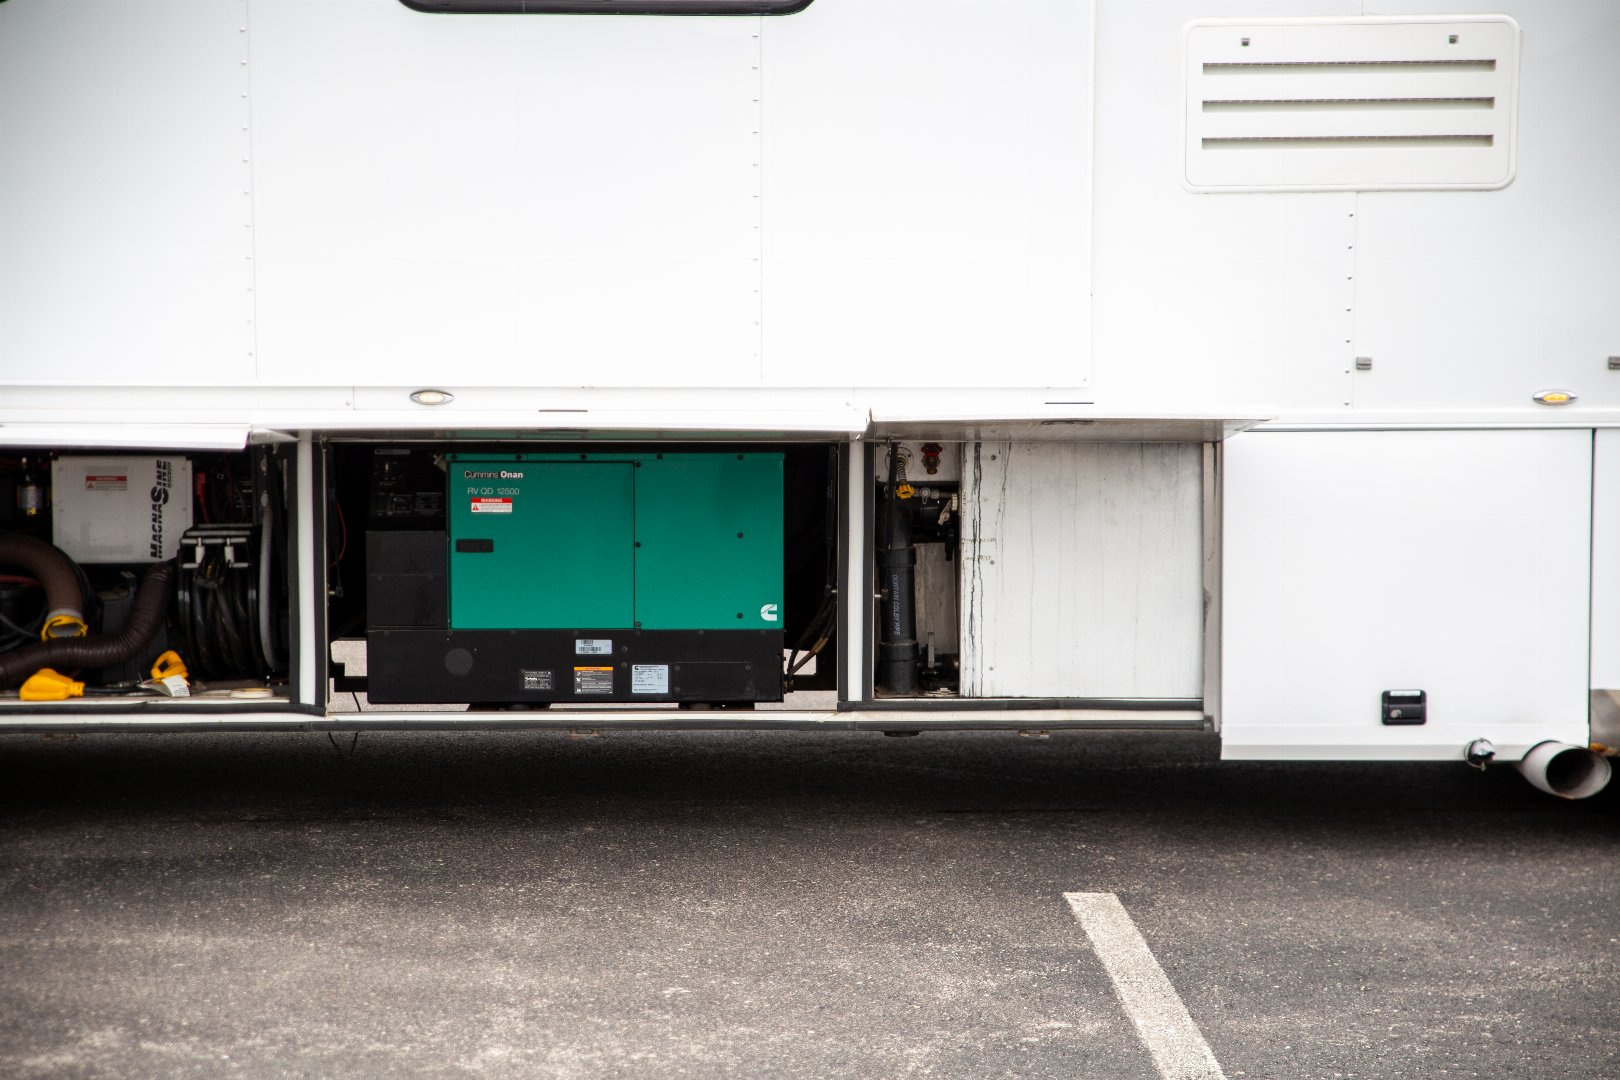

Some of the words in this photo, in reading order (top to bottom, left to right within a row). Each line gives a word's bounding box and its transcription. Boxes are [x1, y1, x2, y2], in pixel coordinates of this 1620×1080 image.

[464, 470, 499, 479] Cummins
[500, 470, 524, 479] Onan
[467, 487, 479, 495] RV
[497, 487, 520, 495] 12500
[150, 459, 169, 560] MAGNASINE
